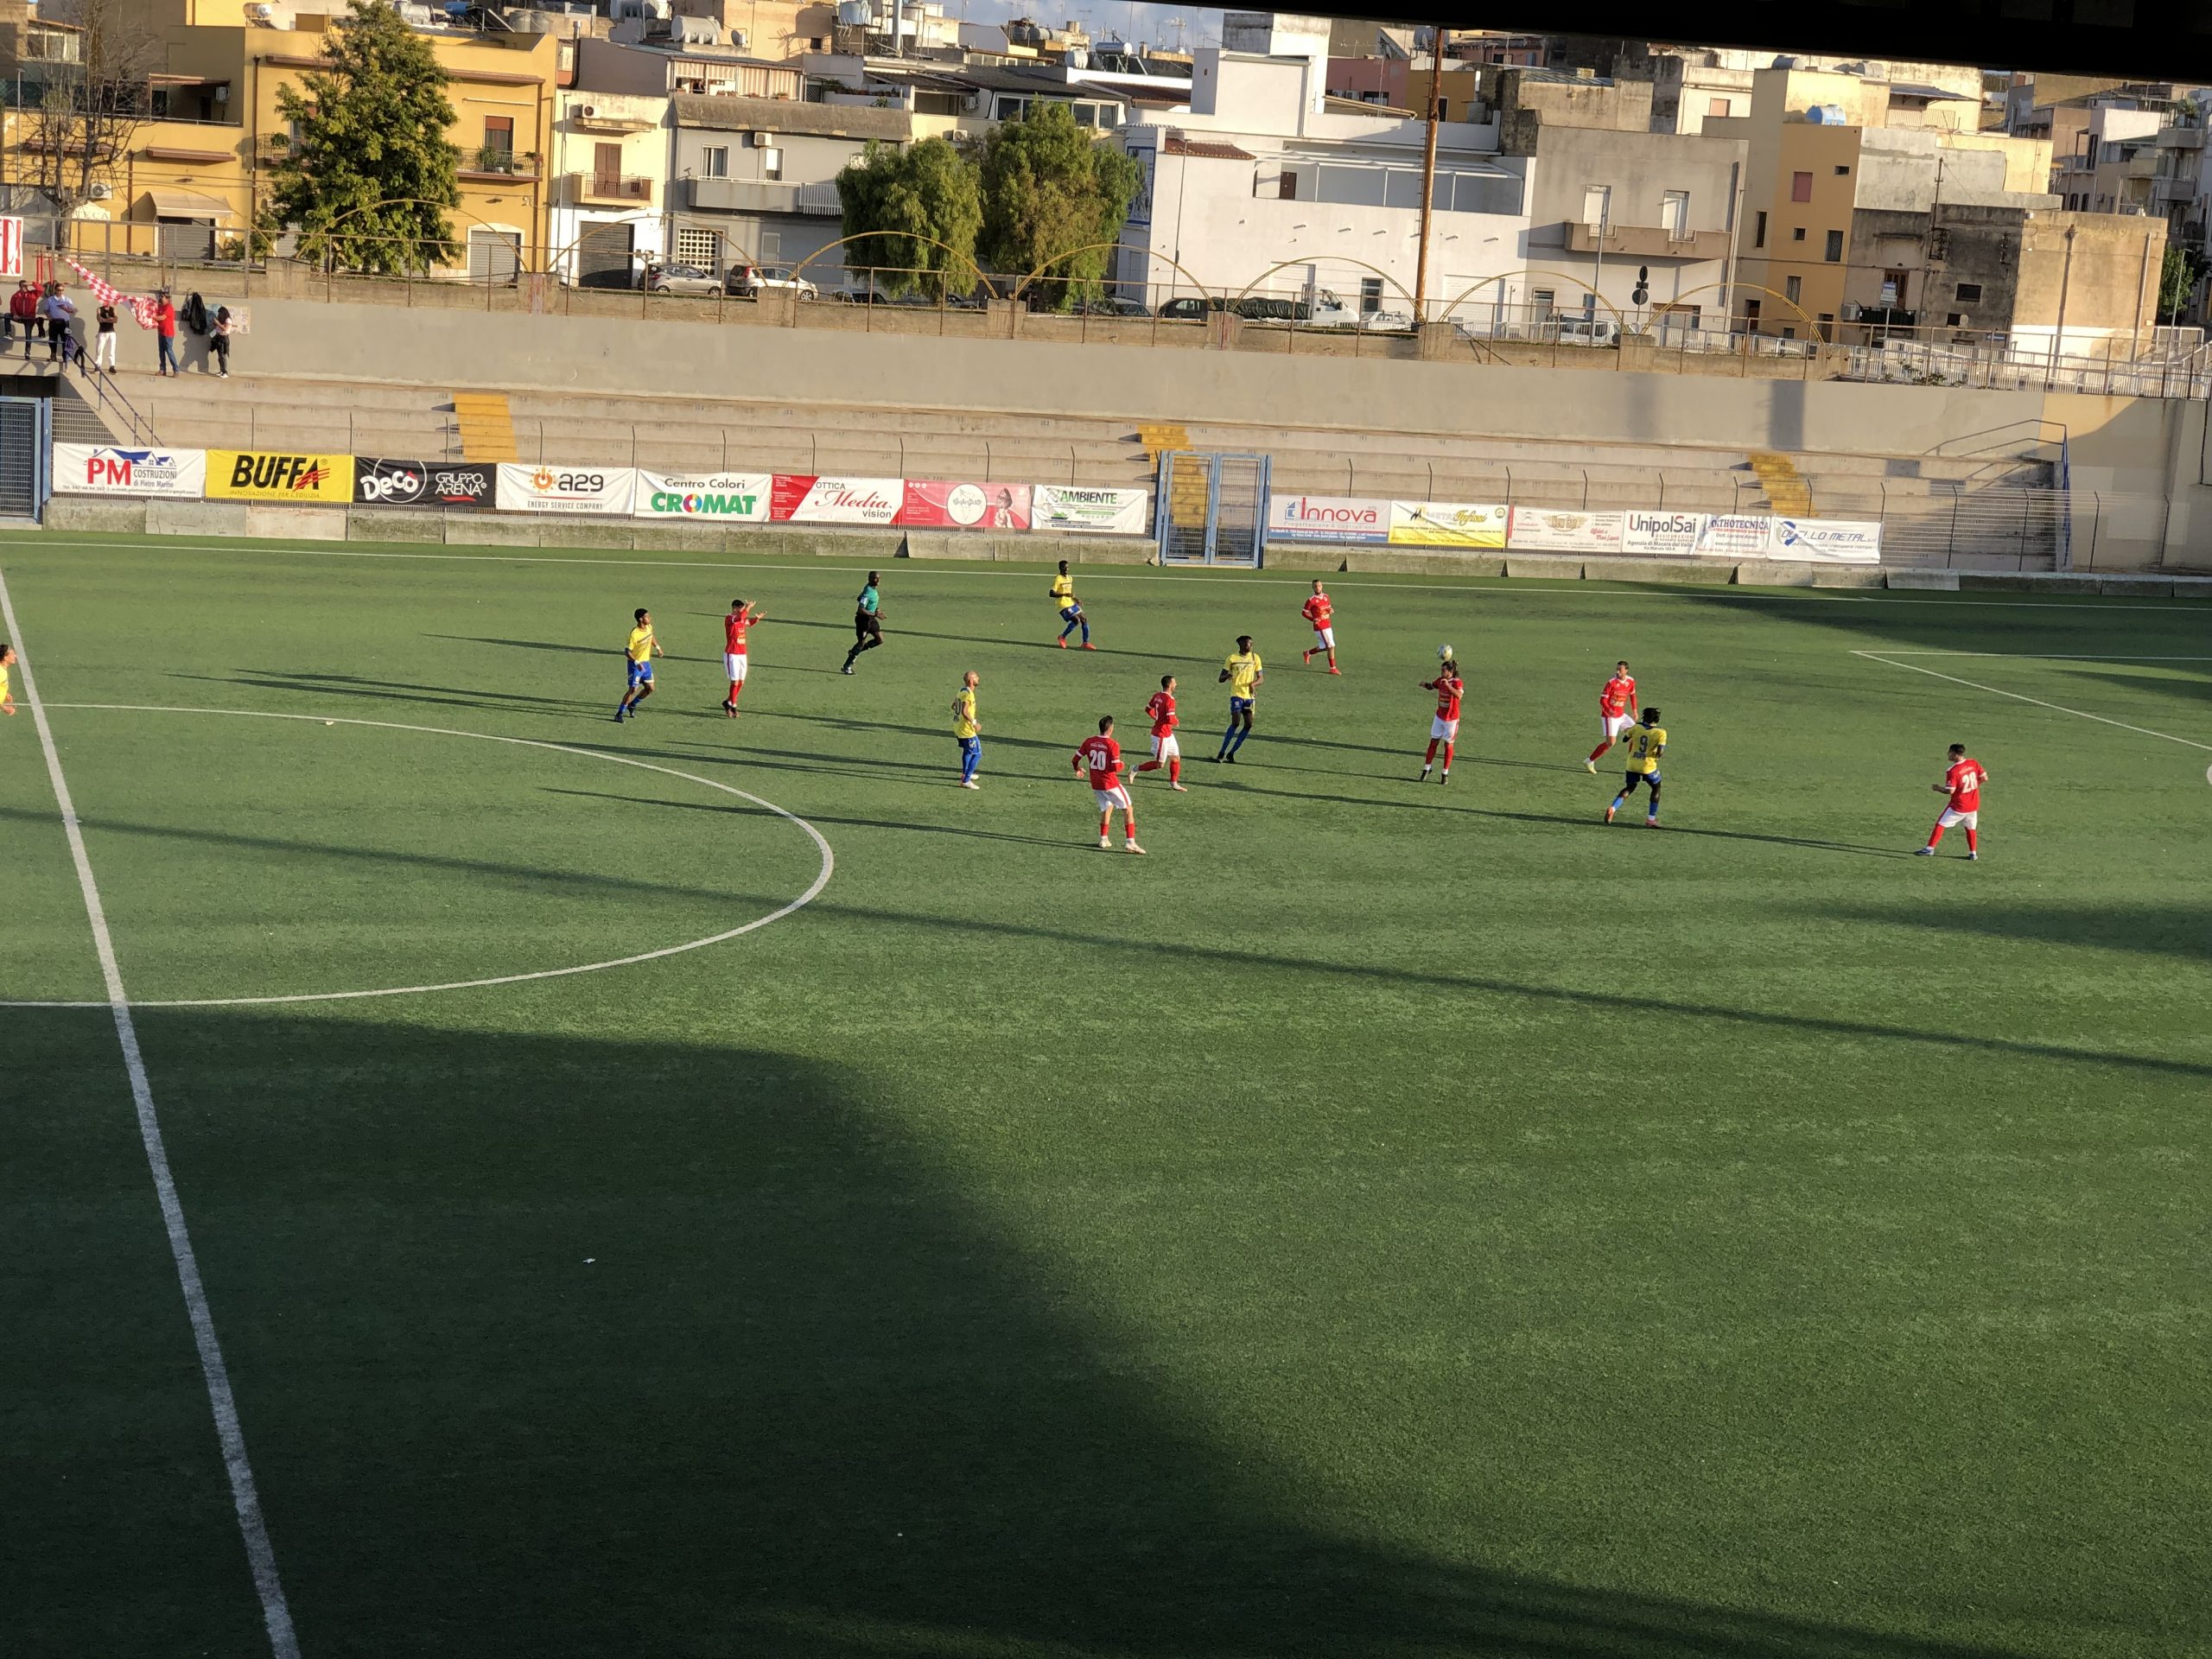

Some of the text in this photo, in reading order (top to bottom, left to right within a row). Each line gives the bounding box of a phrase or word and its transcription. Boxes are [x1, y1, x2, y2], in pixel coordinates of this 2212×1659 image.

[0, 218, 21, 275] RI
[87, 458, 131, 486] PM
[133, 469, 177, 480] COSTRUZIONI
[230, 454, 320, 490] BUFFA
[435, 473, 484, 484] GRUPPO
[435, 483, 483, 496] ARENA
[557, 473, 604, 493] a29
[664, 478, 746, 489] Centro Colori
[816, 481, 846, 490] OTTICA
[527, 500, 549, 509] ENERGY
[651, 492, 757, 515] CROMAT
[1059, 490, 1117, 505] AMBIENTE
[1300, 497, 1377, 524] Innova
[1629, 513, 1697, 537] UnipolSai
[1711, 519, 1769, 530] OTHOTECNICA
[1829, 532, 1867, 542] METAL
[1639, 734, 1649, 753] 9
[1090, 749, 1106, 771] 20
[1961, 771, 1979, 794] 28
